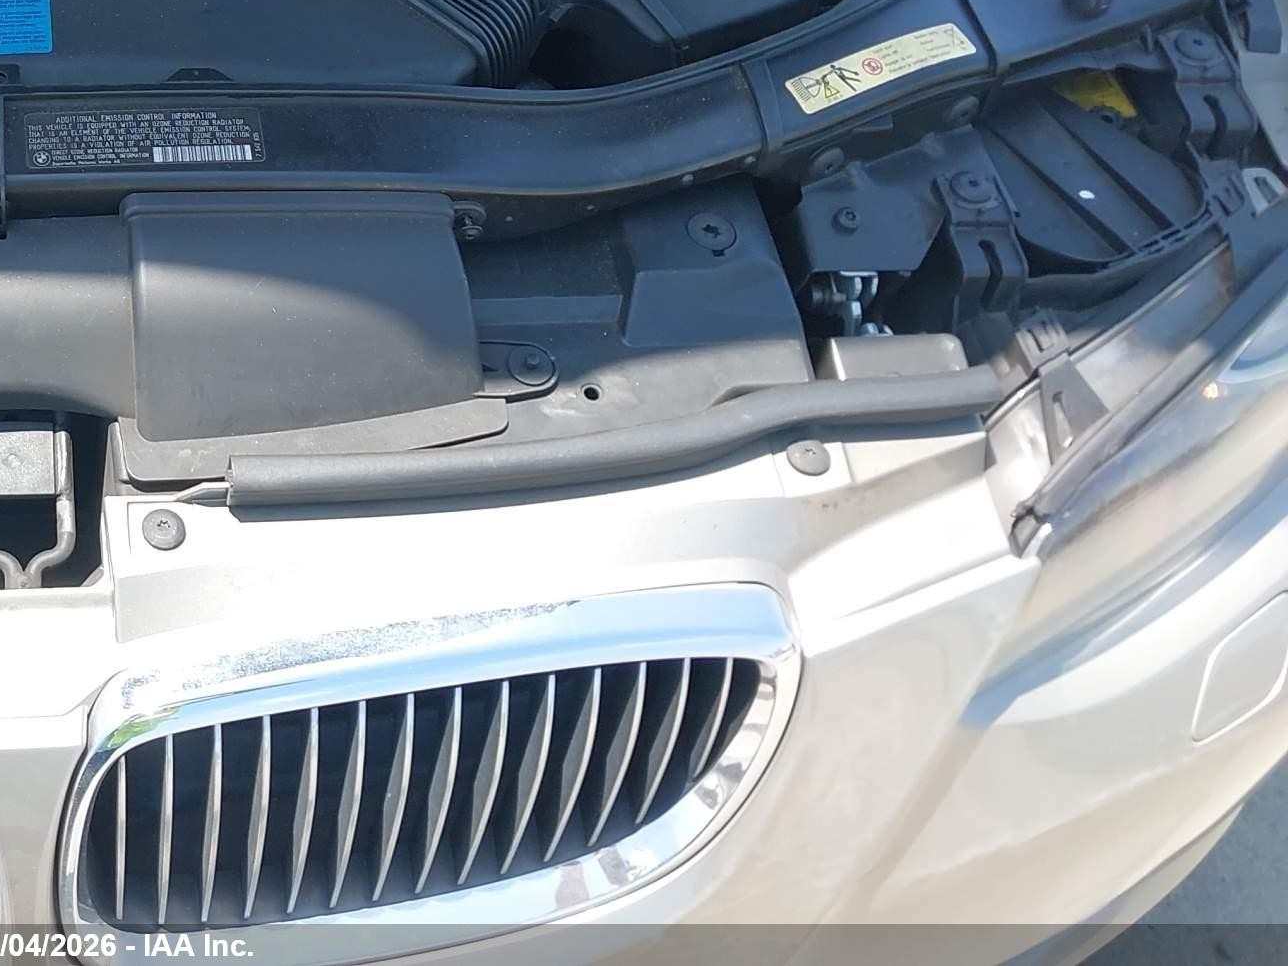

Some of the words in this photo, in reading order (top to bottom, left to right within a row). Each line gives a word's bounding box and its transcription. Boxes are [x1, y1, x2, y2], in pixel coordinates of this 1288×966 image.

[56, 116, 98, 124] ADDITIONAL
[101, 114, 134, 122] EMISSION
[136, 113, 166, 121] CONTROL
[171, 112, 217, 120] INFORMATION
[28, 124, 43, 132] THIS
[45, 123, 72, 131] VEHICLE
[76, 122, 83, 130] IS
[86, 122, 117, 130] EQUIPPED
[120, 121, 137, 129] WITH
[175, 119, 210, 127] REDUCTION
[212, 118, 244, 126] RADIATOR
[28, 130, 44, 138] THAT
[71, 129, 100, 137] ELEMENT
[128, 127, 158, 135] VEHICLE
[160, 126, 191, 134] EMISSION
[83, 134, 115, 142] RADIATOR
[118, 133, 146, 141] WITHOUT
[149, 132, 189, 140] EQUIVALENT
[28, 143, 67, 151] PROPERTIES
[89, 141, 125, 149] VIOLATION
[139, 139, 152, 147] AIR
[153, 138, 190, 146] POLLUTION
